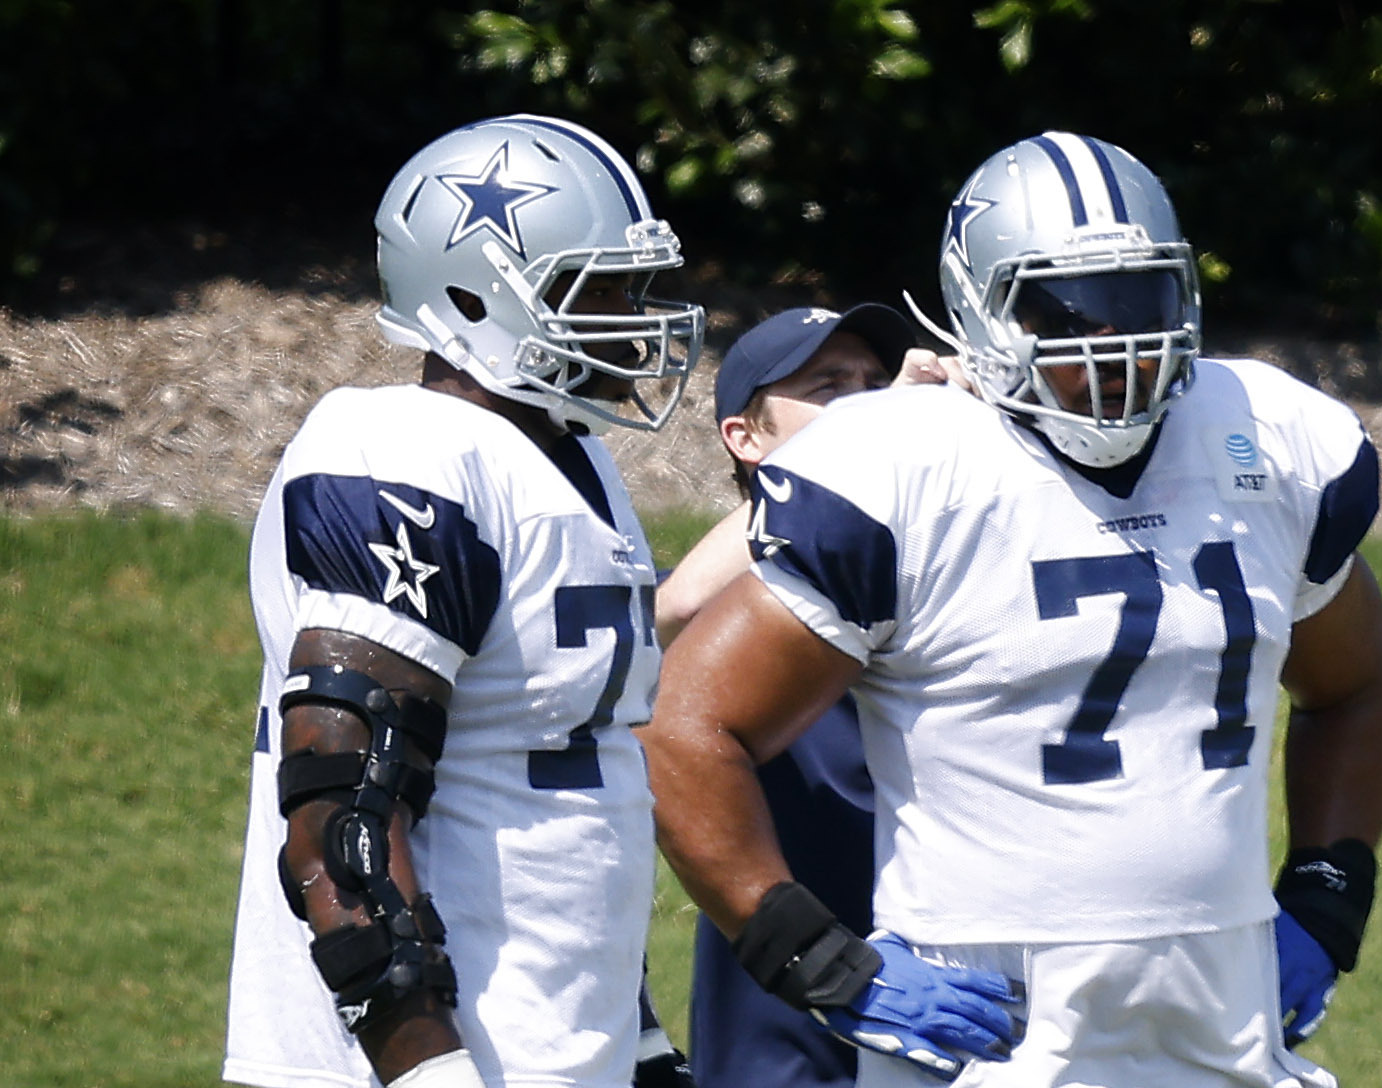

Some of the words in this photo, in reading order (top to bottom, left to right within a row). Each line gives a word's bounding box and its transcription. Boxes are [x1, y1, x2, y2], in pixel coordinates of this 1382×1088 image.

[1096, 513, 1167, 534] COWBOYS
[528, 584, 656, 790] 7
[1031, 541, 1256, 785] 71
